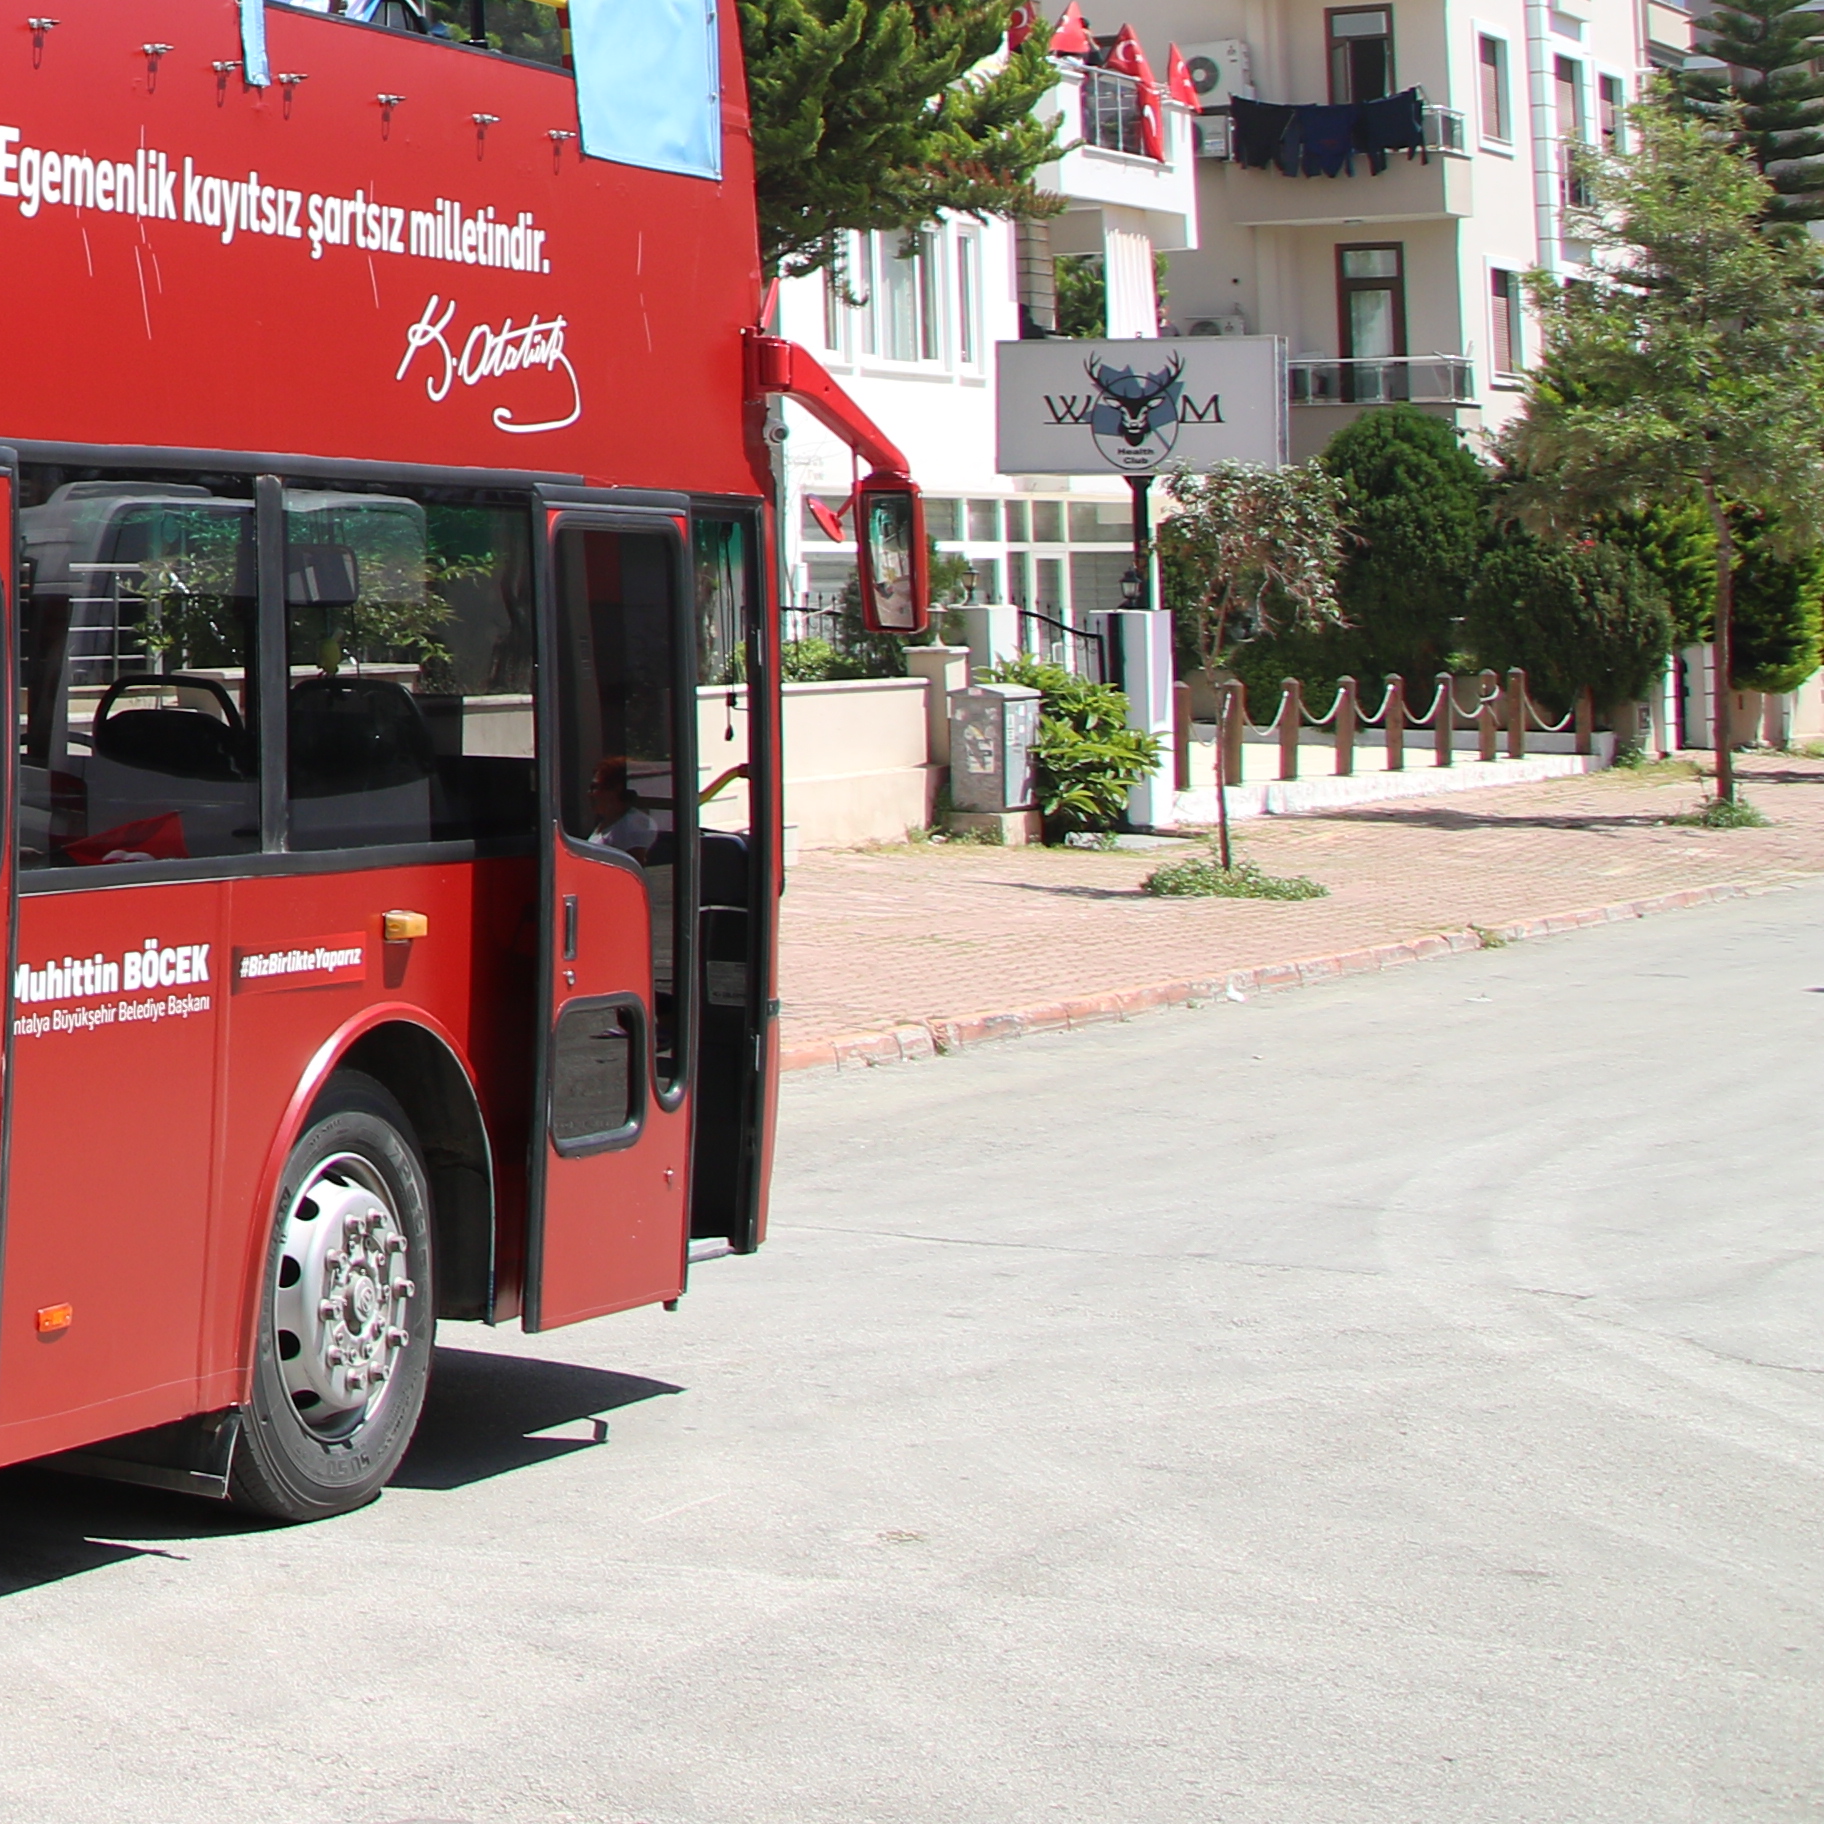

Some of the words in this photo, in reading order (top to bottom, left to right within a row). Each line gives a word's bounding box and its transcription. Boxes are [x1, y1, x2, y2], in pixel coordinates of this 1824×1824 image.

[183, 156, 303, 245] kayıtsız
[307, 189, 405, 260] şartsız
[409, 197, 551, 274] milletindir.
[1123, 457, 1149, 465] Club
[14, 953, 119, 1004] Muhittin
[123, 938, 211, 992] BÖCEK
[239, 947, 363, 978] #BizBirlikteYaparız
[52, 1003, 118, 1034] Büyükşehir
[118, 999, 166, 1023] Belediye
[167, 993, 211, 1018] Başkanı
